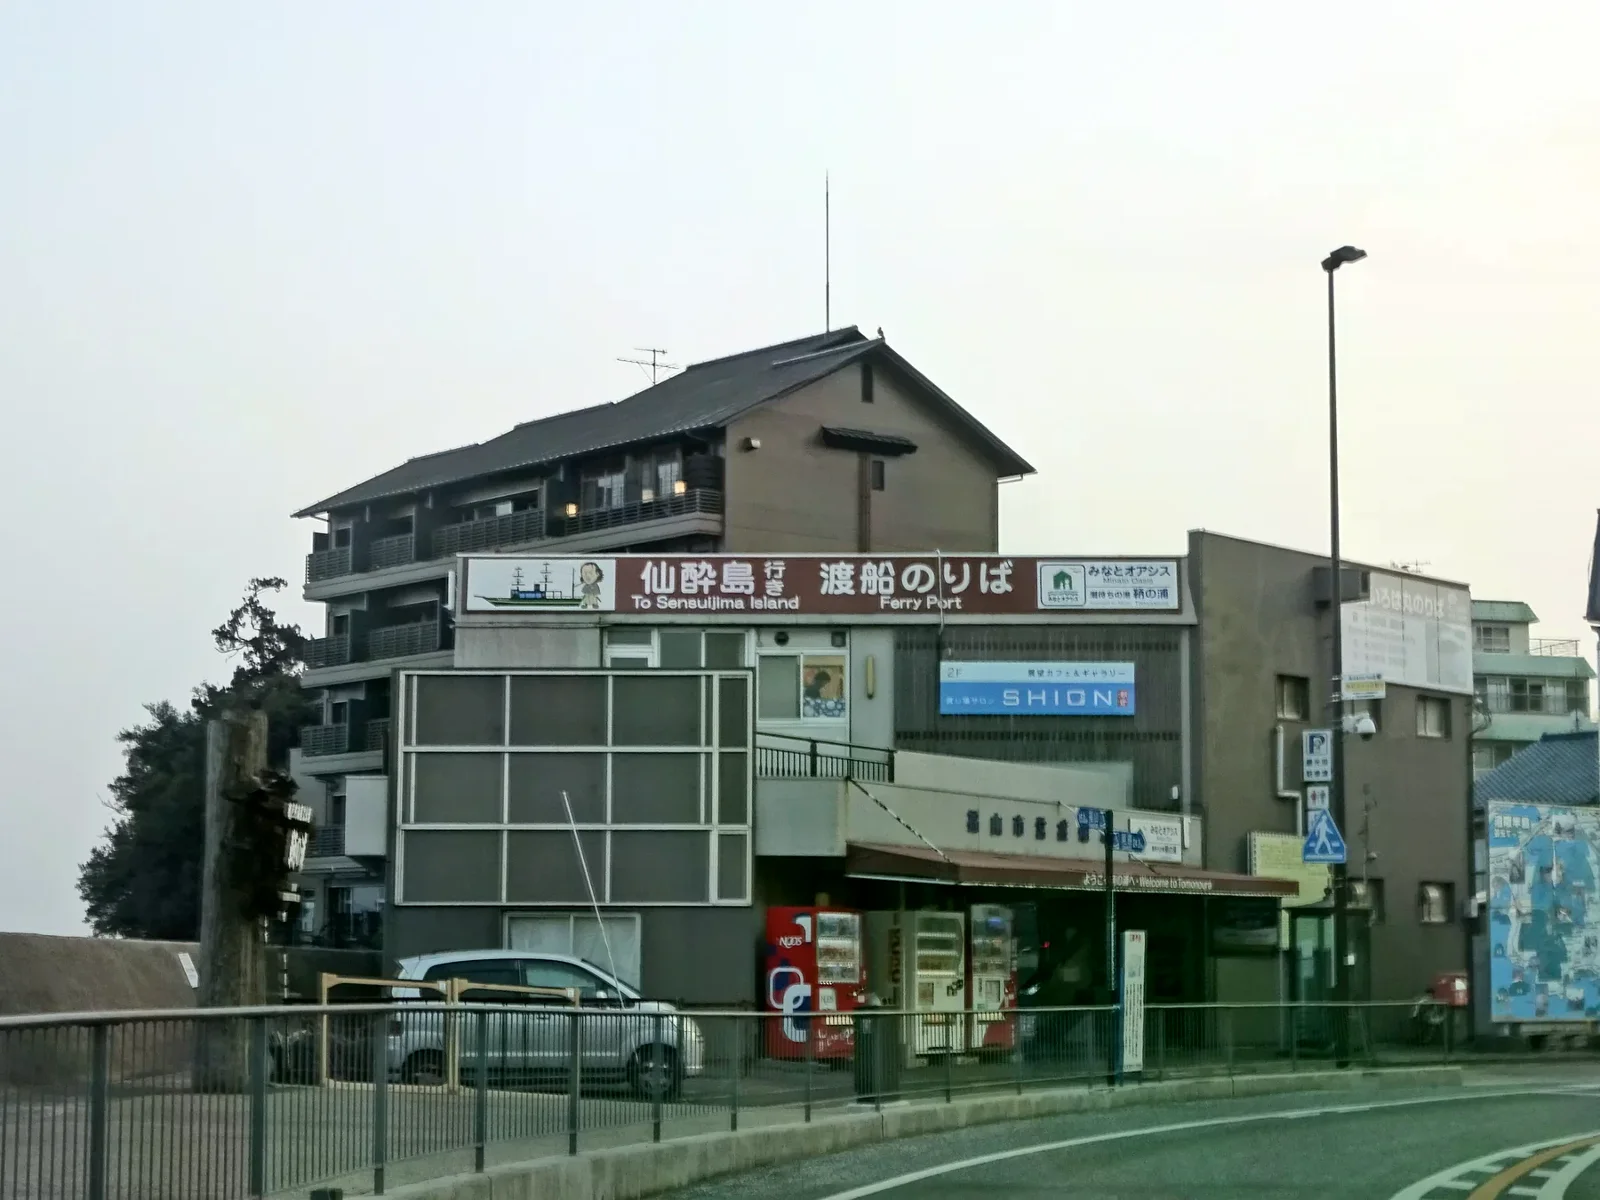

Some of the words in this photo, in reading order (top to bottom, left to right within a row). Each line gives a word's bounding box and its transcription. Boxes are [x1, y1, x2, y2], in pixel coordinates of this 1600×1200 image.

[640, 560, 755, 595] 仙酔島
[819, 560, 1014, 595] 渡船のりば
[1088, 565, 1171, 577] みなとオアシス
[631, 595, 652, 610] To
[656, 595, 745, 611] Sensuijima
[750, 595, 800, 610] Island
[880, 596, 922, 611] Ferry
[926, 595, 963, 610] Port
[947, 667, 963, 678] 2F
[1003, 689, 1113, 707] SHION
[1308, 734, 1326, 755] P
[1139, 876, 1169, 889] Welcome
[1170, 877, 1178, 889] to
